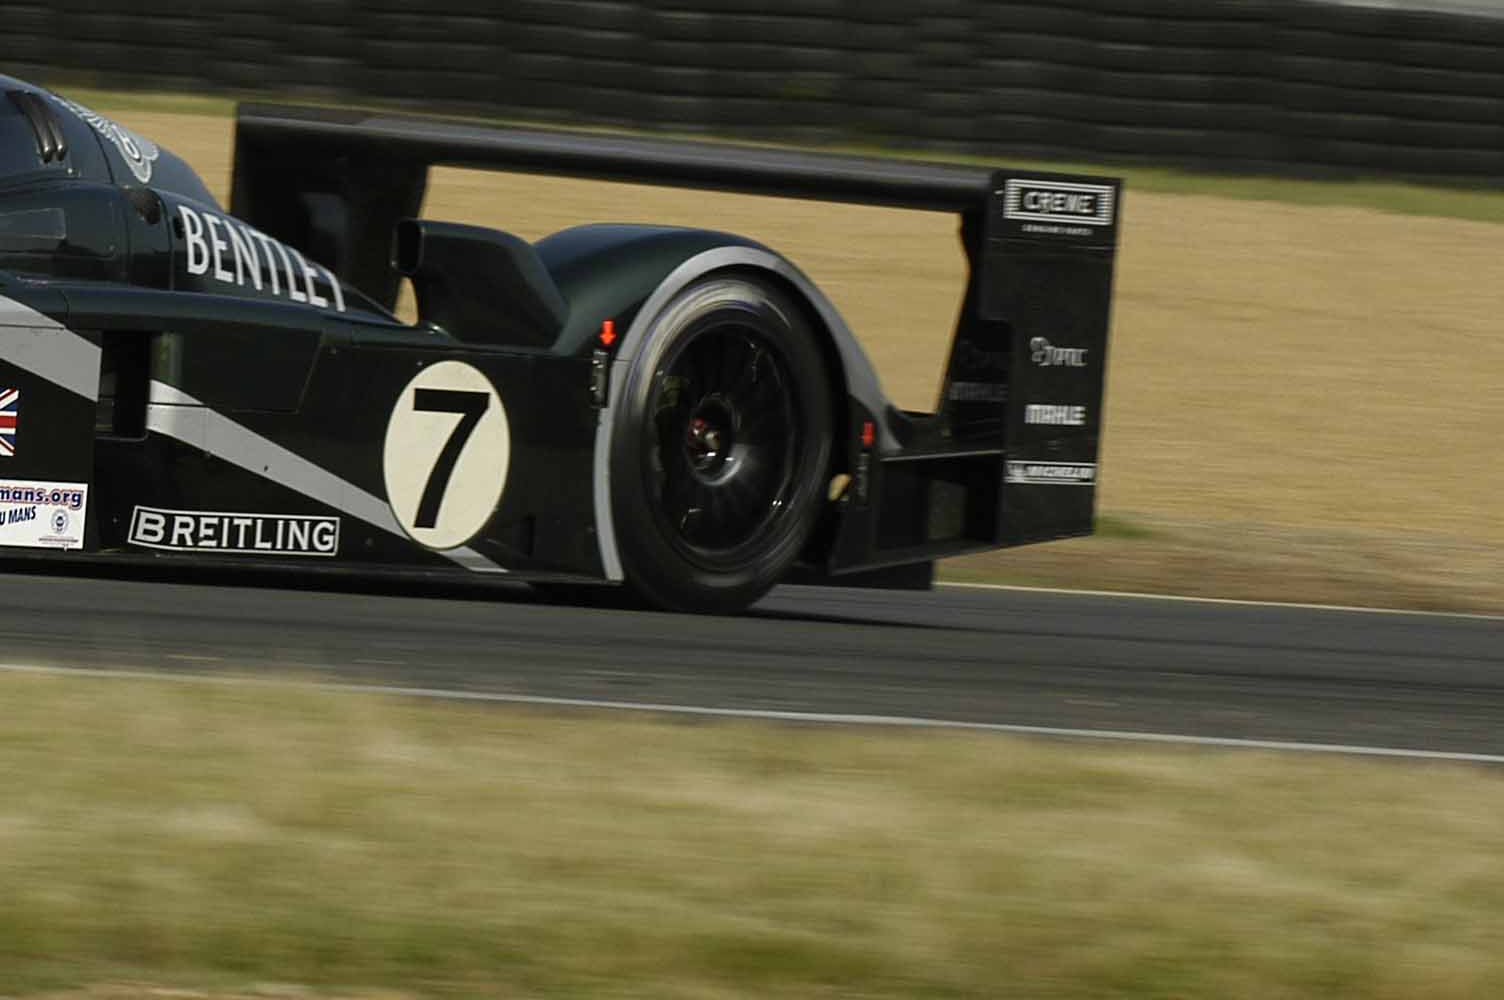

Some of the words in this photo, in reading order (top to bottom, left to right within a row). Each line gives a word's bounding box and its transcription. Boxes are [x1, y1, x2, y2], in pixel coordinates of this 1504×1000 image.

[412, 387, 491, 529] 7
[8, 505, 37, 524] MANS
[134, 511, 336, 551] BREITLING
